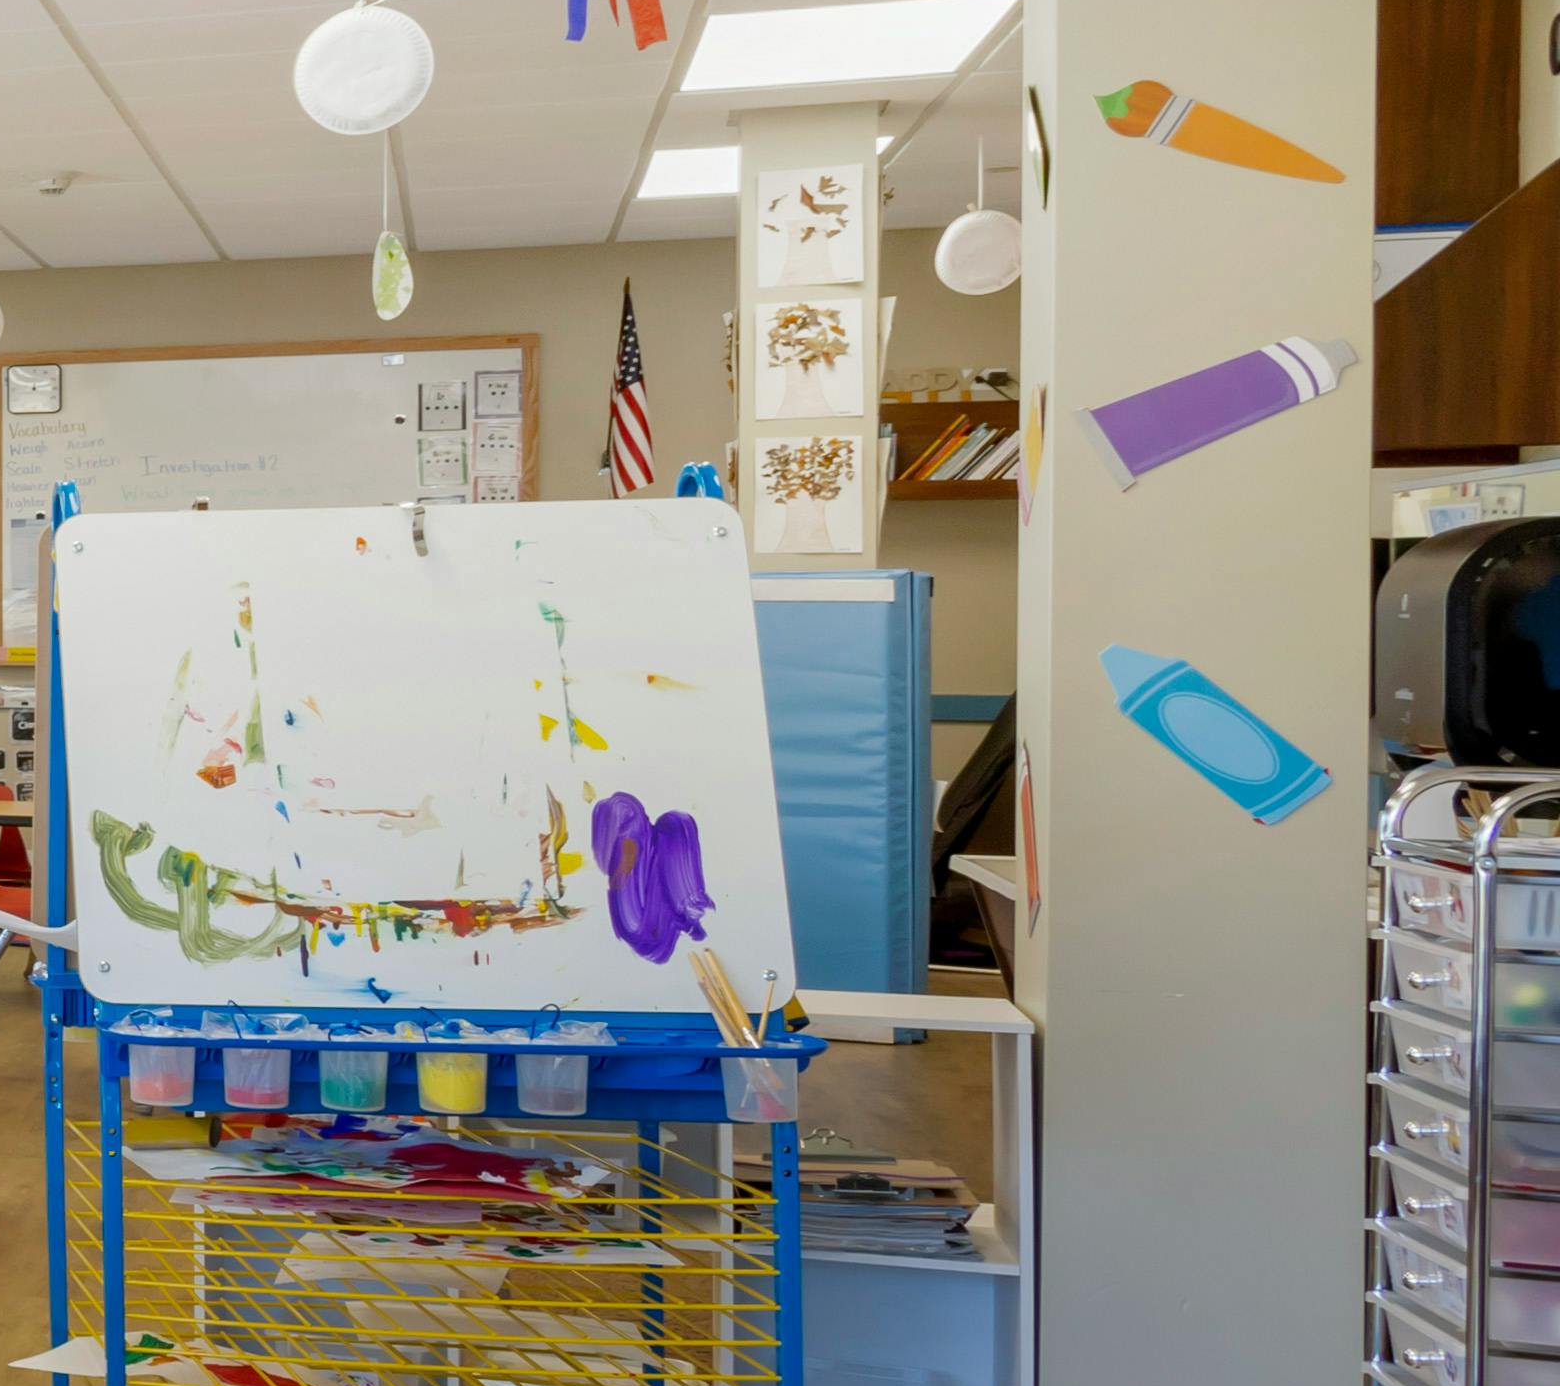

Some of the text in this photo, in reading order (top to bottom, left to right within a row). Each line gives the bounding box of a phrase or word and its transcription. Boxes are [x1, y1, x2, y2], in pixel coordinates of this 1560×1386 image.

[9, 420, 87, 438] Vocabulary
[7, 461, 41, 476] Scale
[139, 455, 251, 477] Investigation
